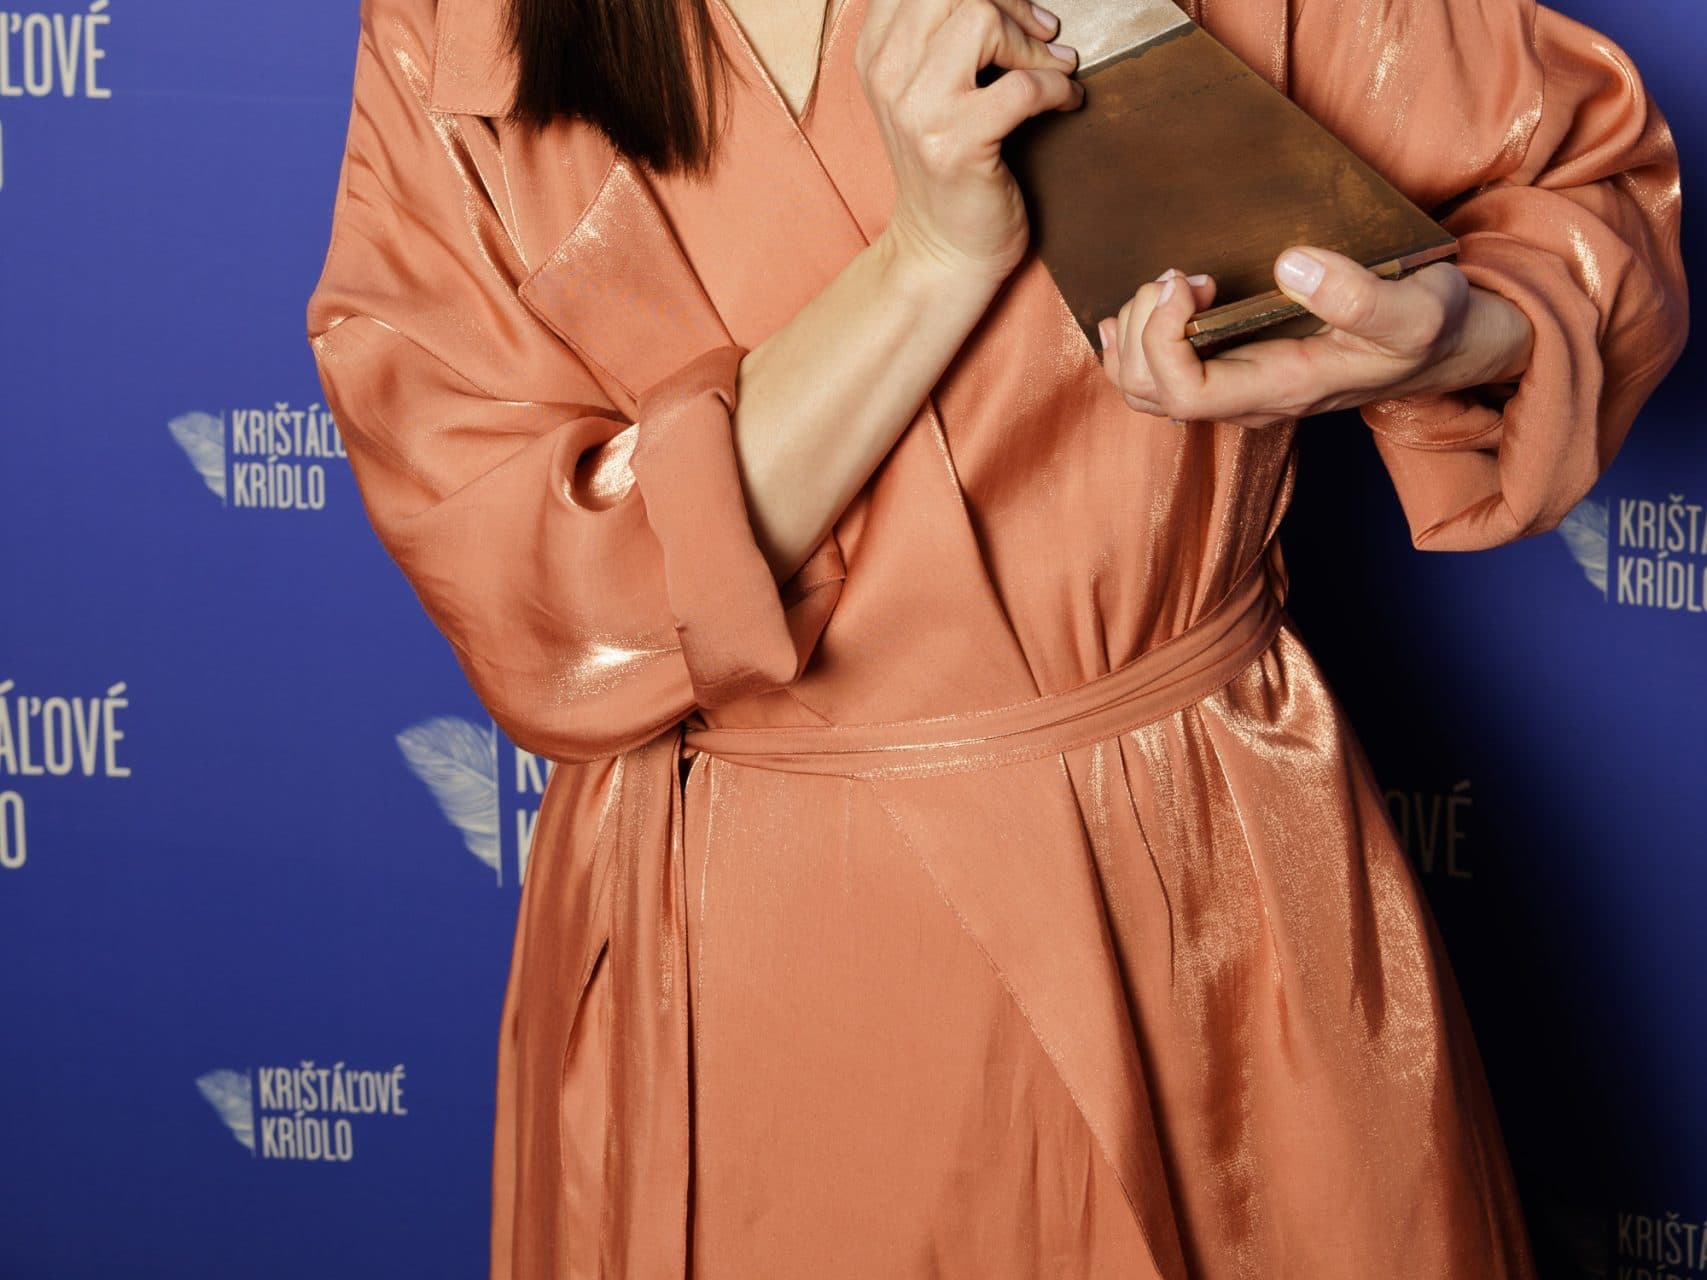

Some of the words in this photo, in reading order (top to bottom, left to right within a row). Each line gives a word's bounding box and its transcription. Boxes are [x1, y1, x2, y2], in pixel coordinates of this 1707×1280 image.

[233, 455, 325, 510] KRÍDLO
[1618, 551, 1707, 612] KRÍDL
[259, 1061, 407, 1115] KRIŠTÁĽOVÉ
[262, 1111, 353, 1162] KRÍDLO
